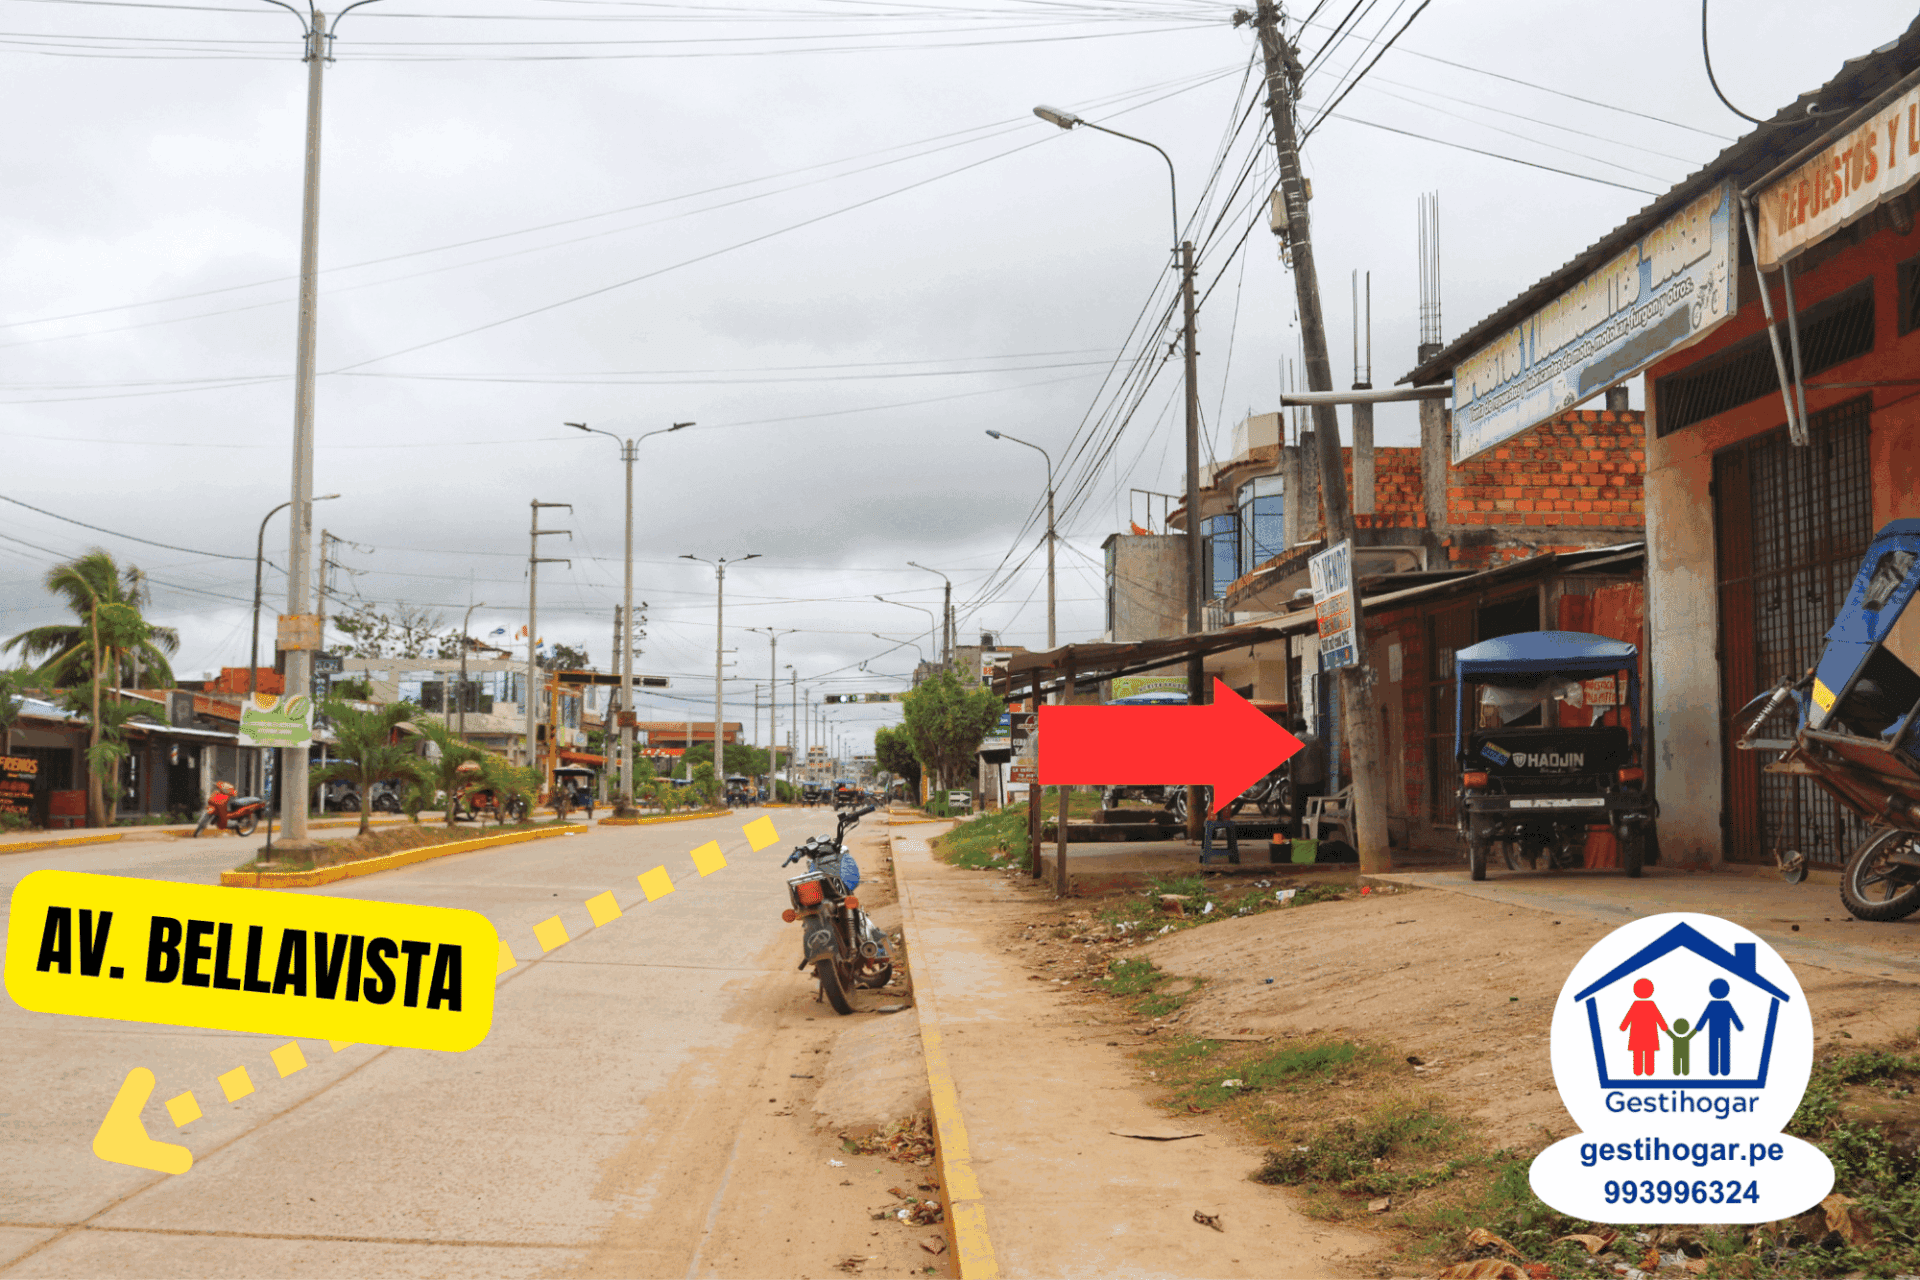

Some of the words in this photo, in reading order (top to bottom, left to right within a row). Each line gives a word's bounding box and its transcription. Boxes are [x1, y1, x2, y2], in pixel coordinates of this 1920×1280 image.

[1777, 131, 1878, 237] REPUESTOS
[1888, 113, 1900, 170] Y
[1522, 315, 1533, 371] Y
[1527, 753, 1584, 768] HAOJIN
